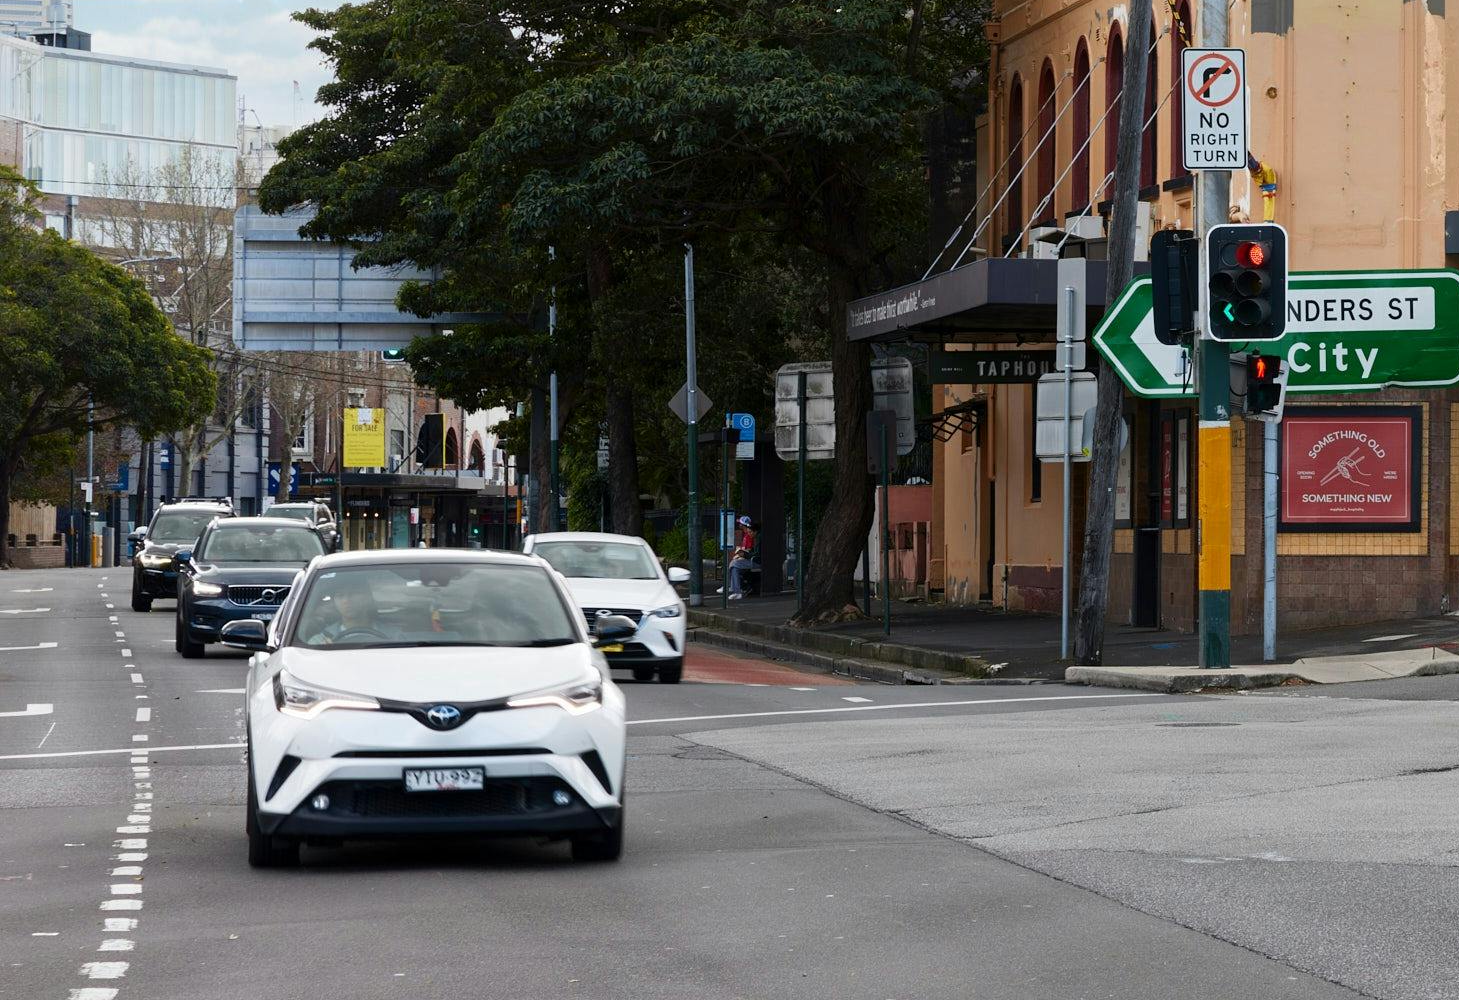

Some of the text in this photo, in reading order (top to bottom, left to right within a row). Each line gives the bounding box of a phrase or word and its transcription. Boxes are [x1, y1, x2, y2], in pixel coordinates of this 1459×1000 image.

[1200, 112, 1230, 129] NO
[1190, 133, 1239, 146] RIGHT
[1193, 150, 1238, 162] TURN
[1287, 297, 1419, 322] NDERS ST
[976, 360, 1057, 377] TAPHOU
[1287, 341, 1379, 379] City
[351, 424, 379, 432] FOR SALE
[1308, 430, 1386, 459] SOMETHING OLD
[1302, 494, 1393, 503] SOMETHING NEW
